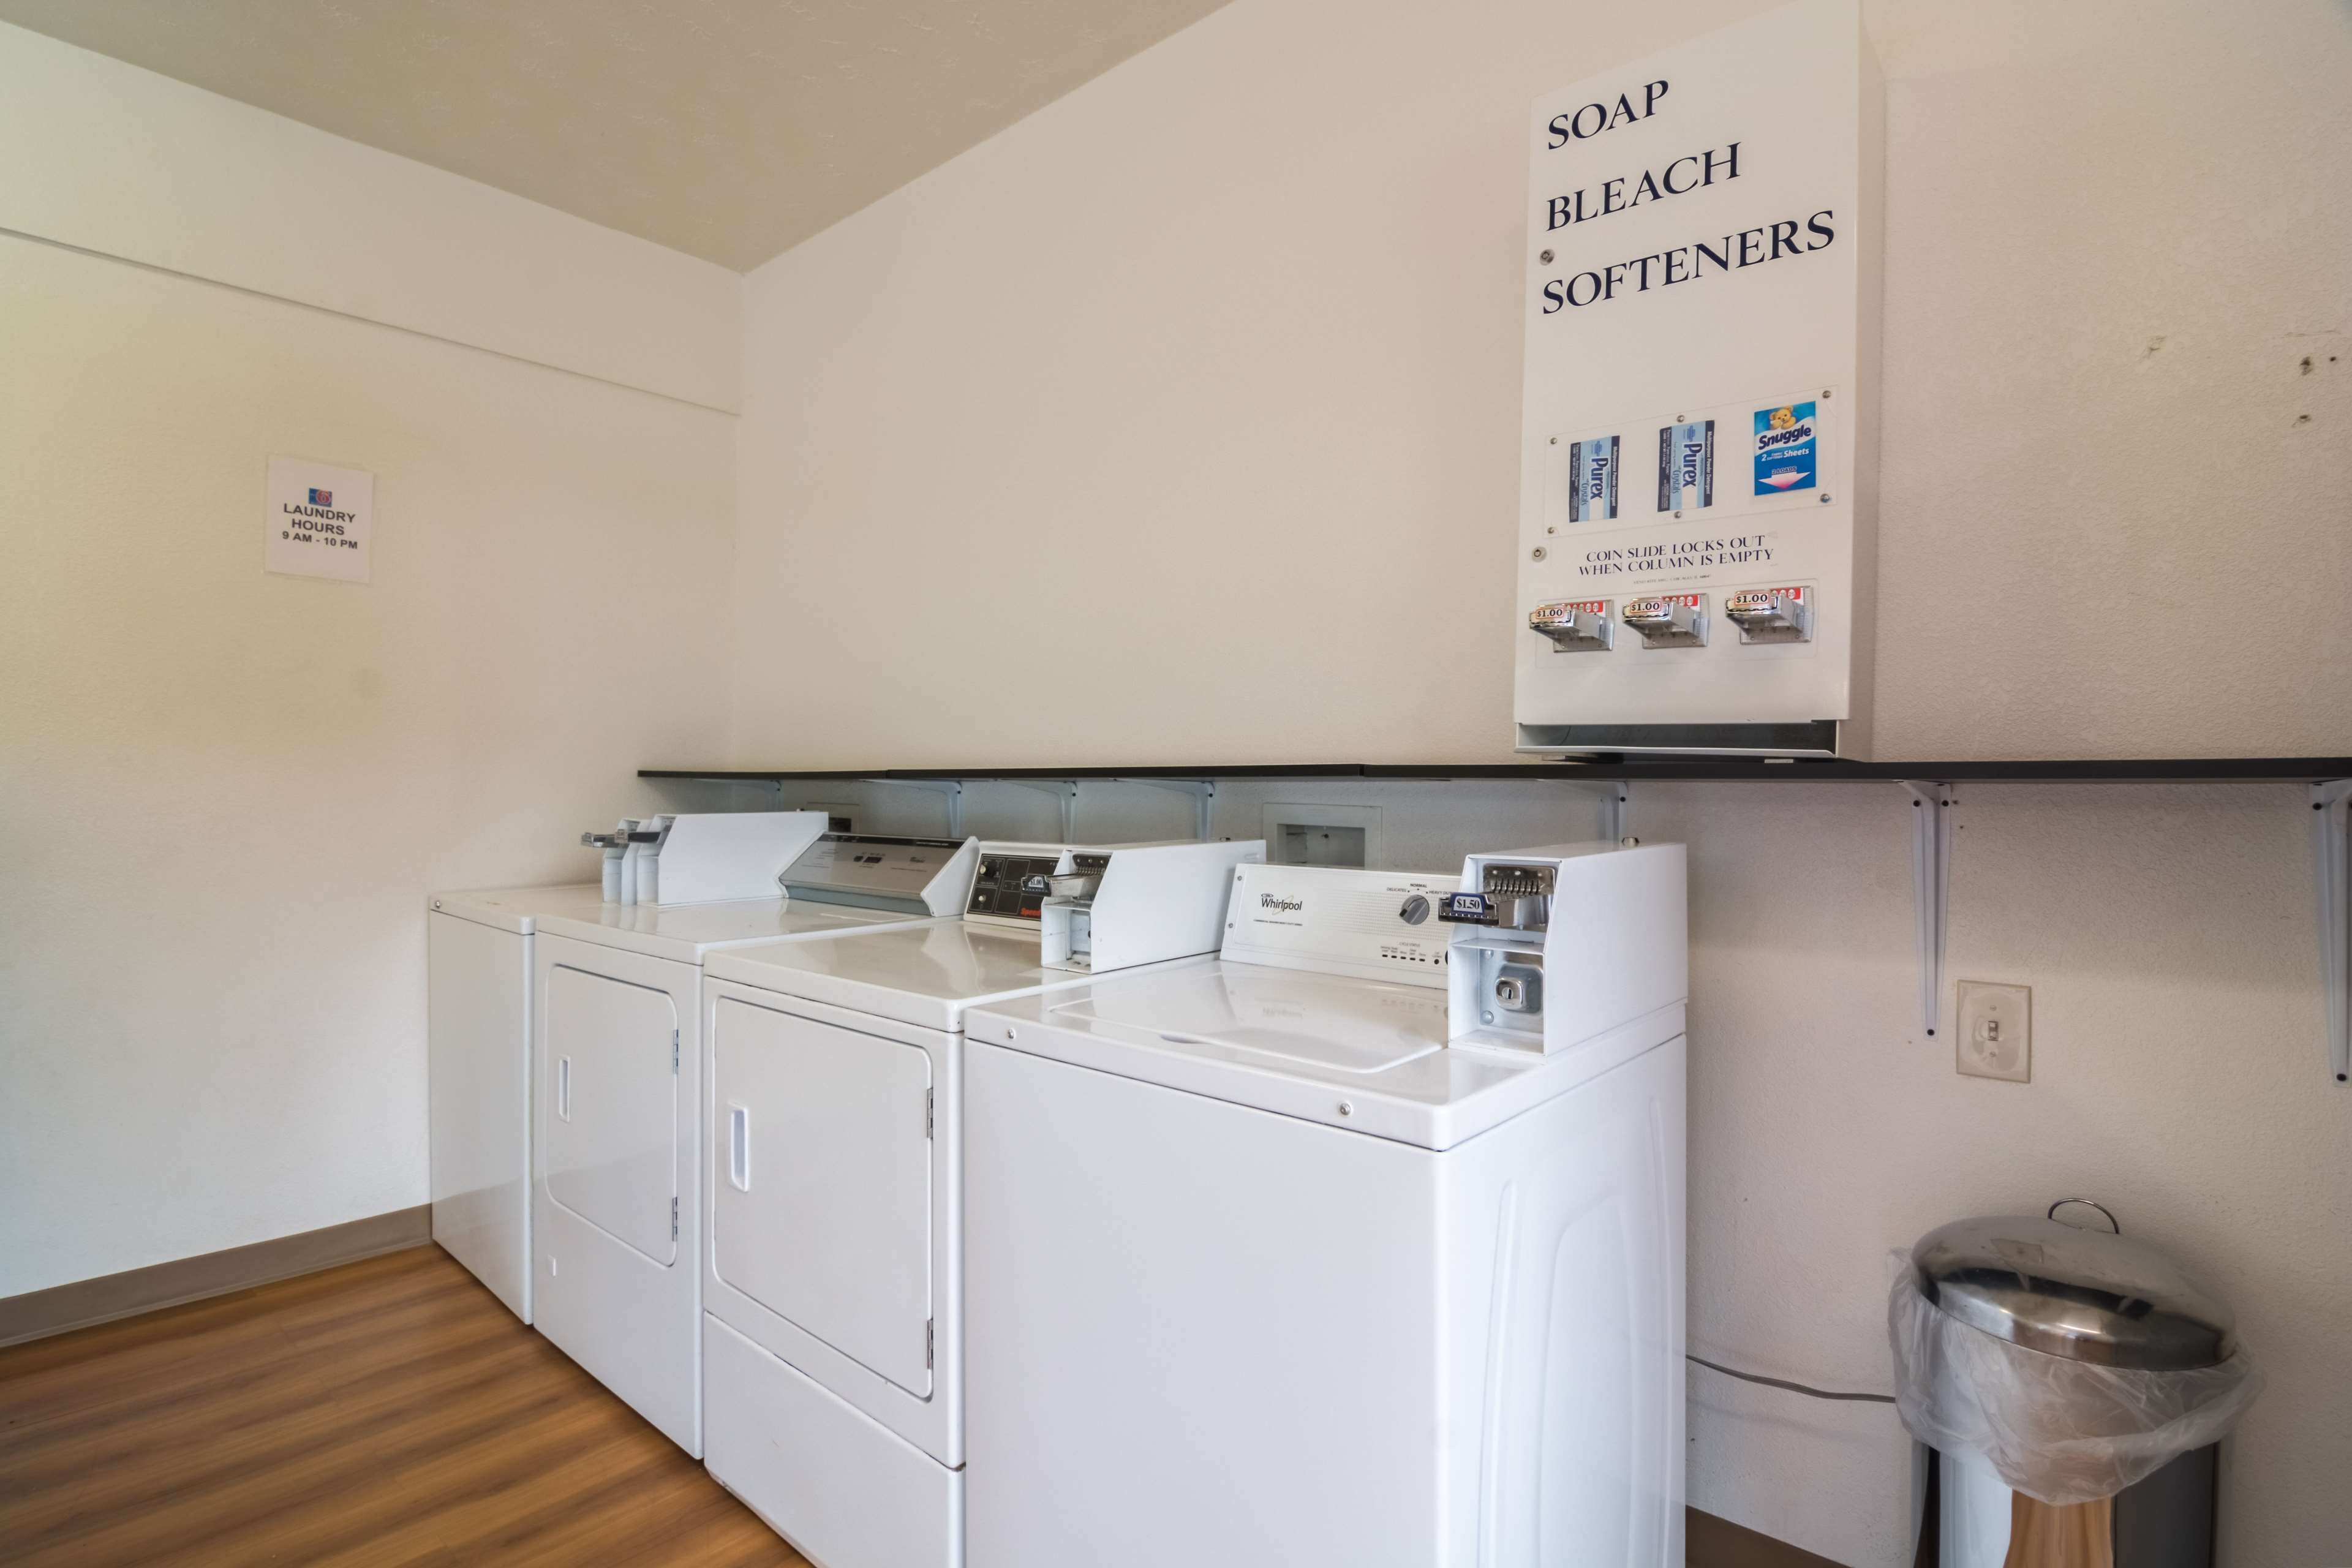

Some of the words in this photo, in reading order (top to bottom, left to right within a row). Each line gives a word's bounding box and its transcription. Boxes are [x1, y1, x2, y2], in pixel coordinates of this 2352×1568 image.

[1548, 80, 1669, 150] SOAP
[1545, 141, 1742, 232] BLEACH
[1542, 210, 1834, 315] SOFTENERS
[1758, 424, 1811, 450] Snuggle
[1783, 448, 1809, 458] Sheets
[1683, 443, 1703, 488] Purex
[1590, 458, 1608, 500] Purex
[1672, 470, 1681, 494] Crystals
[1581, 483, 1589, 506] Crystals
[284, 503, 356, 523] LAUNDRY
[292, 518, 345, 535] HOURS
[282, 531, 289, 540] 9
[292, 533, 312, 543] AM
[324, 537, 336, 546] 10
[340, 540, 358, 549] PM
[1586, 549, 1623, 562] COIN
[1627, 545, 1667, 559] SLIDE
[1673, 539, 1724, 554] LOCKS
[1730, 535, 1765, 549] OUT
[1579, 562, 1623, 576] WHEN
[1628, 556, 1694, 572] COLUMN
[1700, 554, 1713, 566] IS
[1719, 549, 1774, 564] EMPTY
[1631, 602, 1660, 611] $1.00
[1736, 594, 1768, 603] $1.00
[1537, 609, 1562, 617] $1.00
[1261, 897, 1302, 912] Whirlpool
[1456, 897, 1480, 910] $1.50
